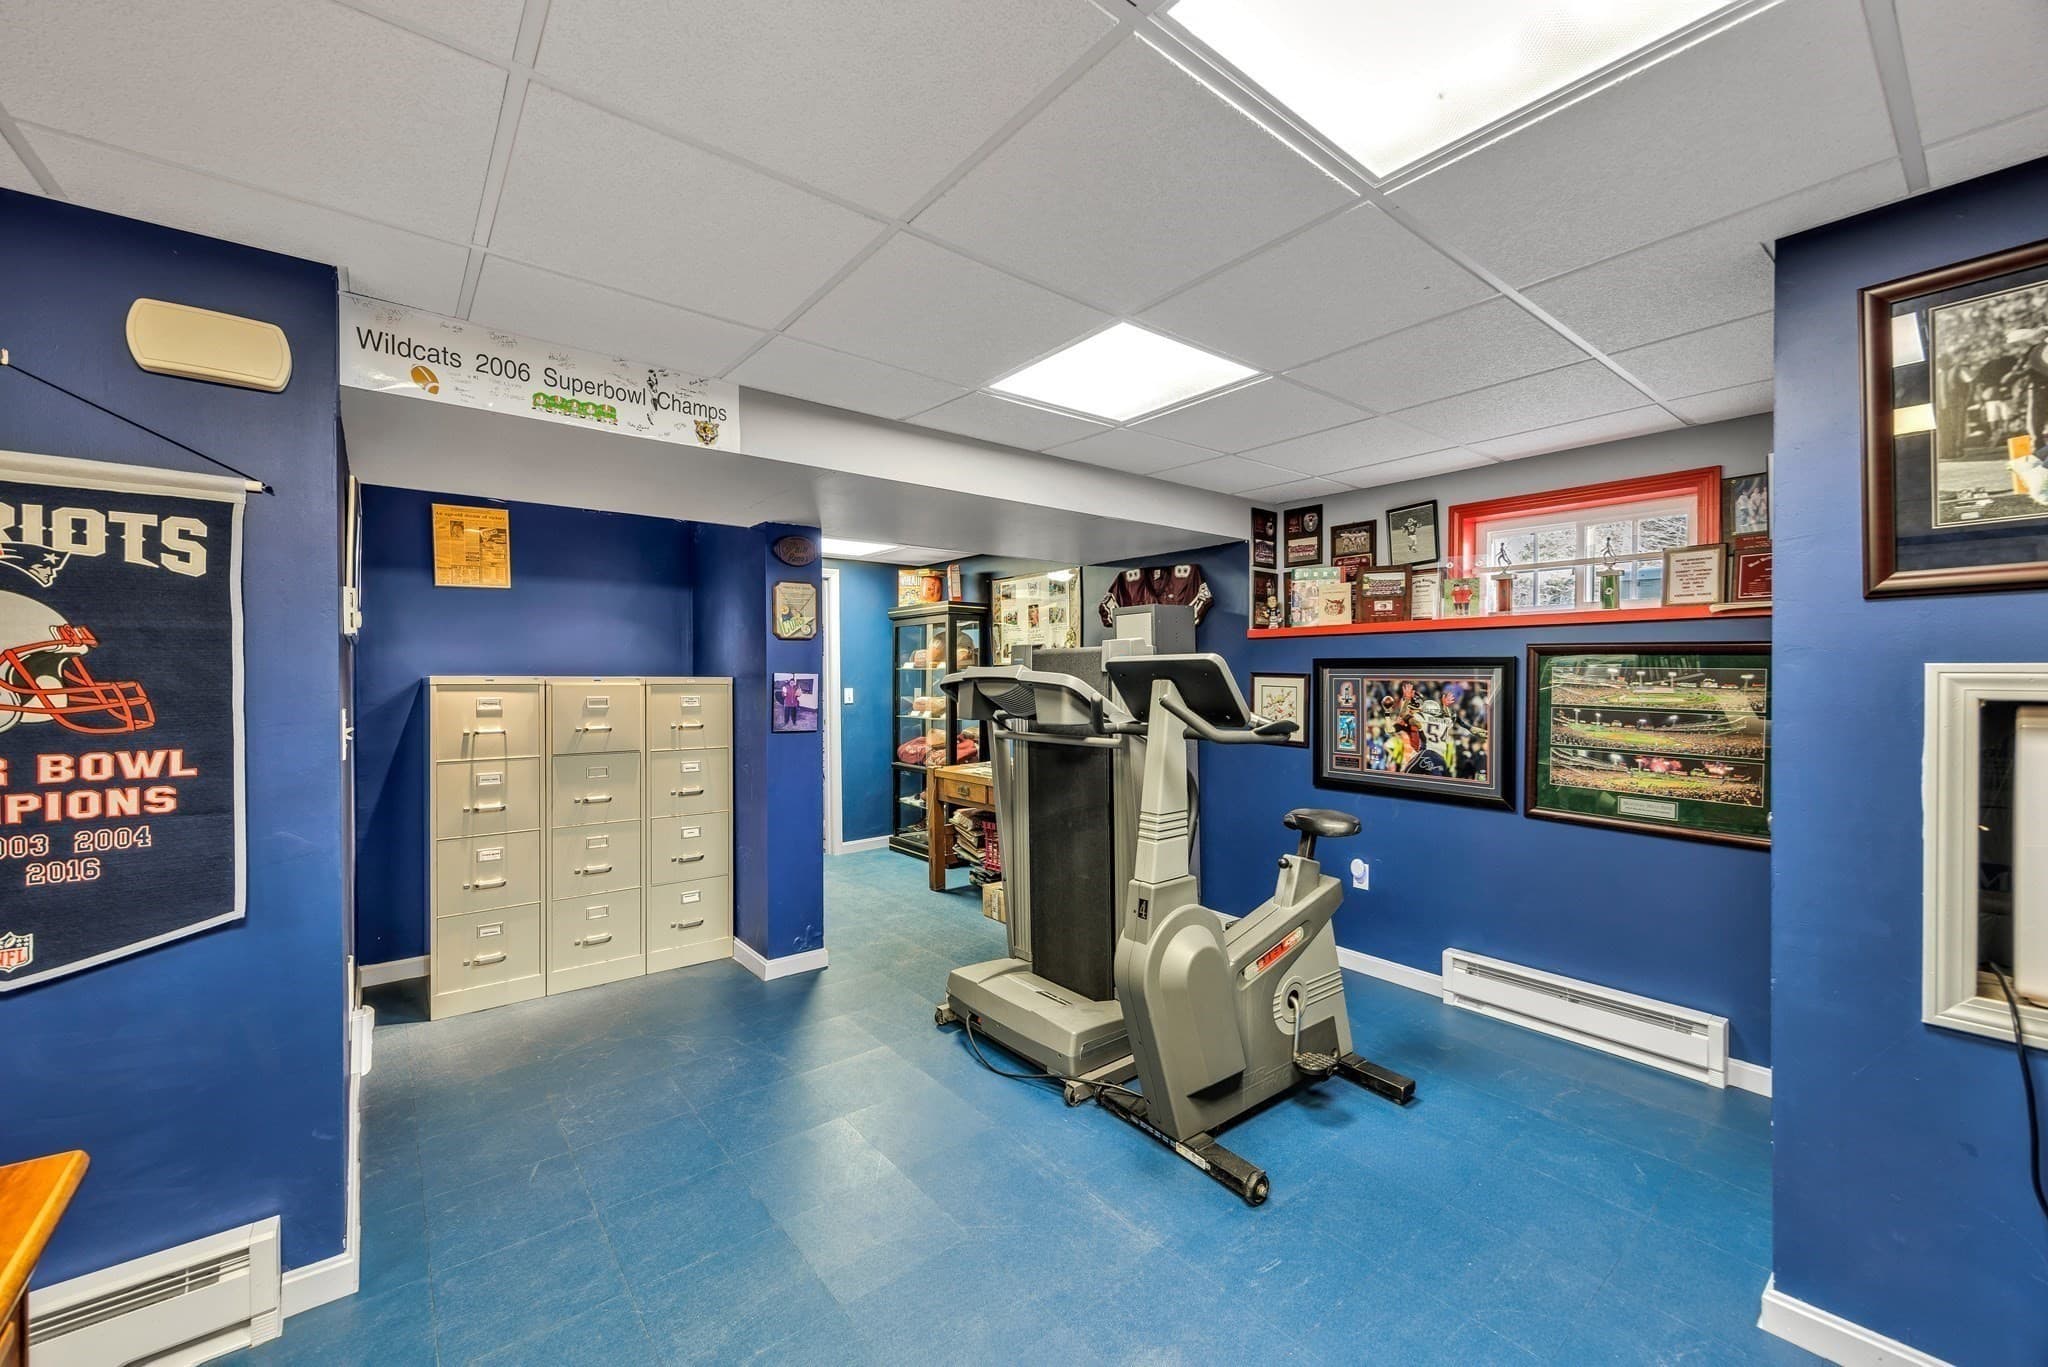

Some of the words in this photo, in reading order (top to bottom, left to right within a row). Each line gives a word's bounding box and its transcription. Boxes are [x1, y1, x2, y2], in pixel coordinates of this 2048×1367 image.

[356, 326, 462, 368] Wildcats
[475, 353, 531, 382] 2006
[543, 367, 646, 406] Superbowl
[657, 391, 727, 422] Champs
[37, 749, 198, 785] BOWL
[0, 833, 49, 860] 03
[74, 826, 152, 853] 2004
[26, 858, 101, 886] 2016
